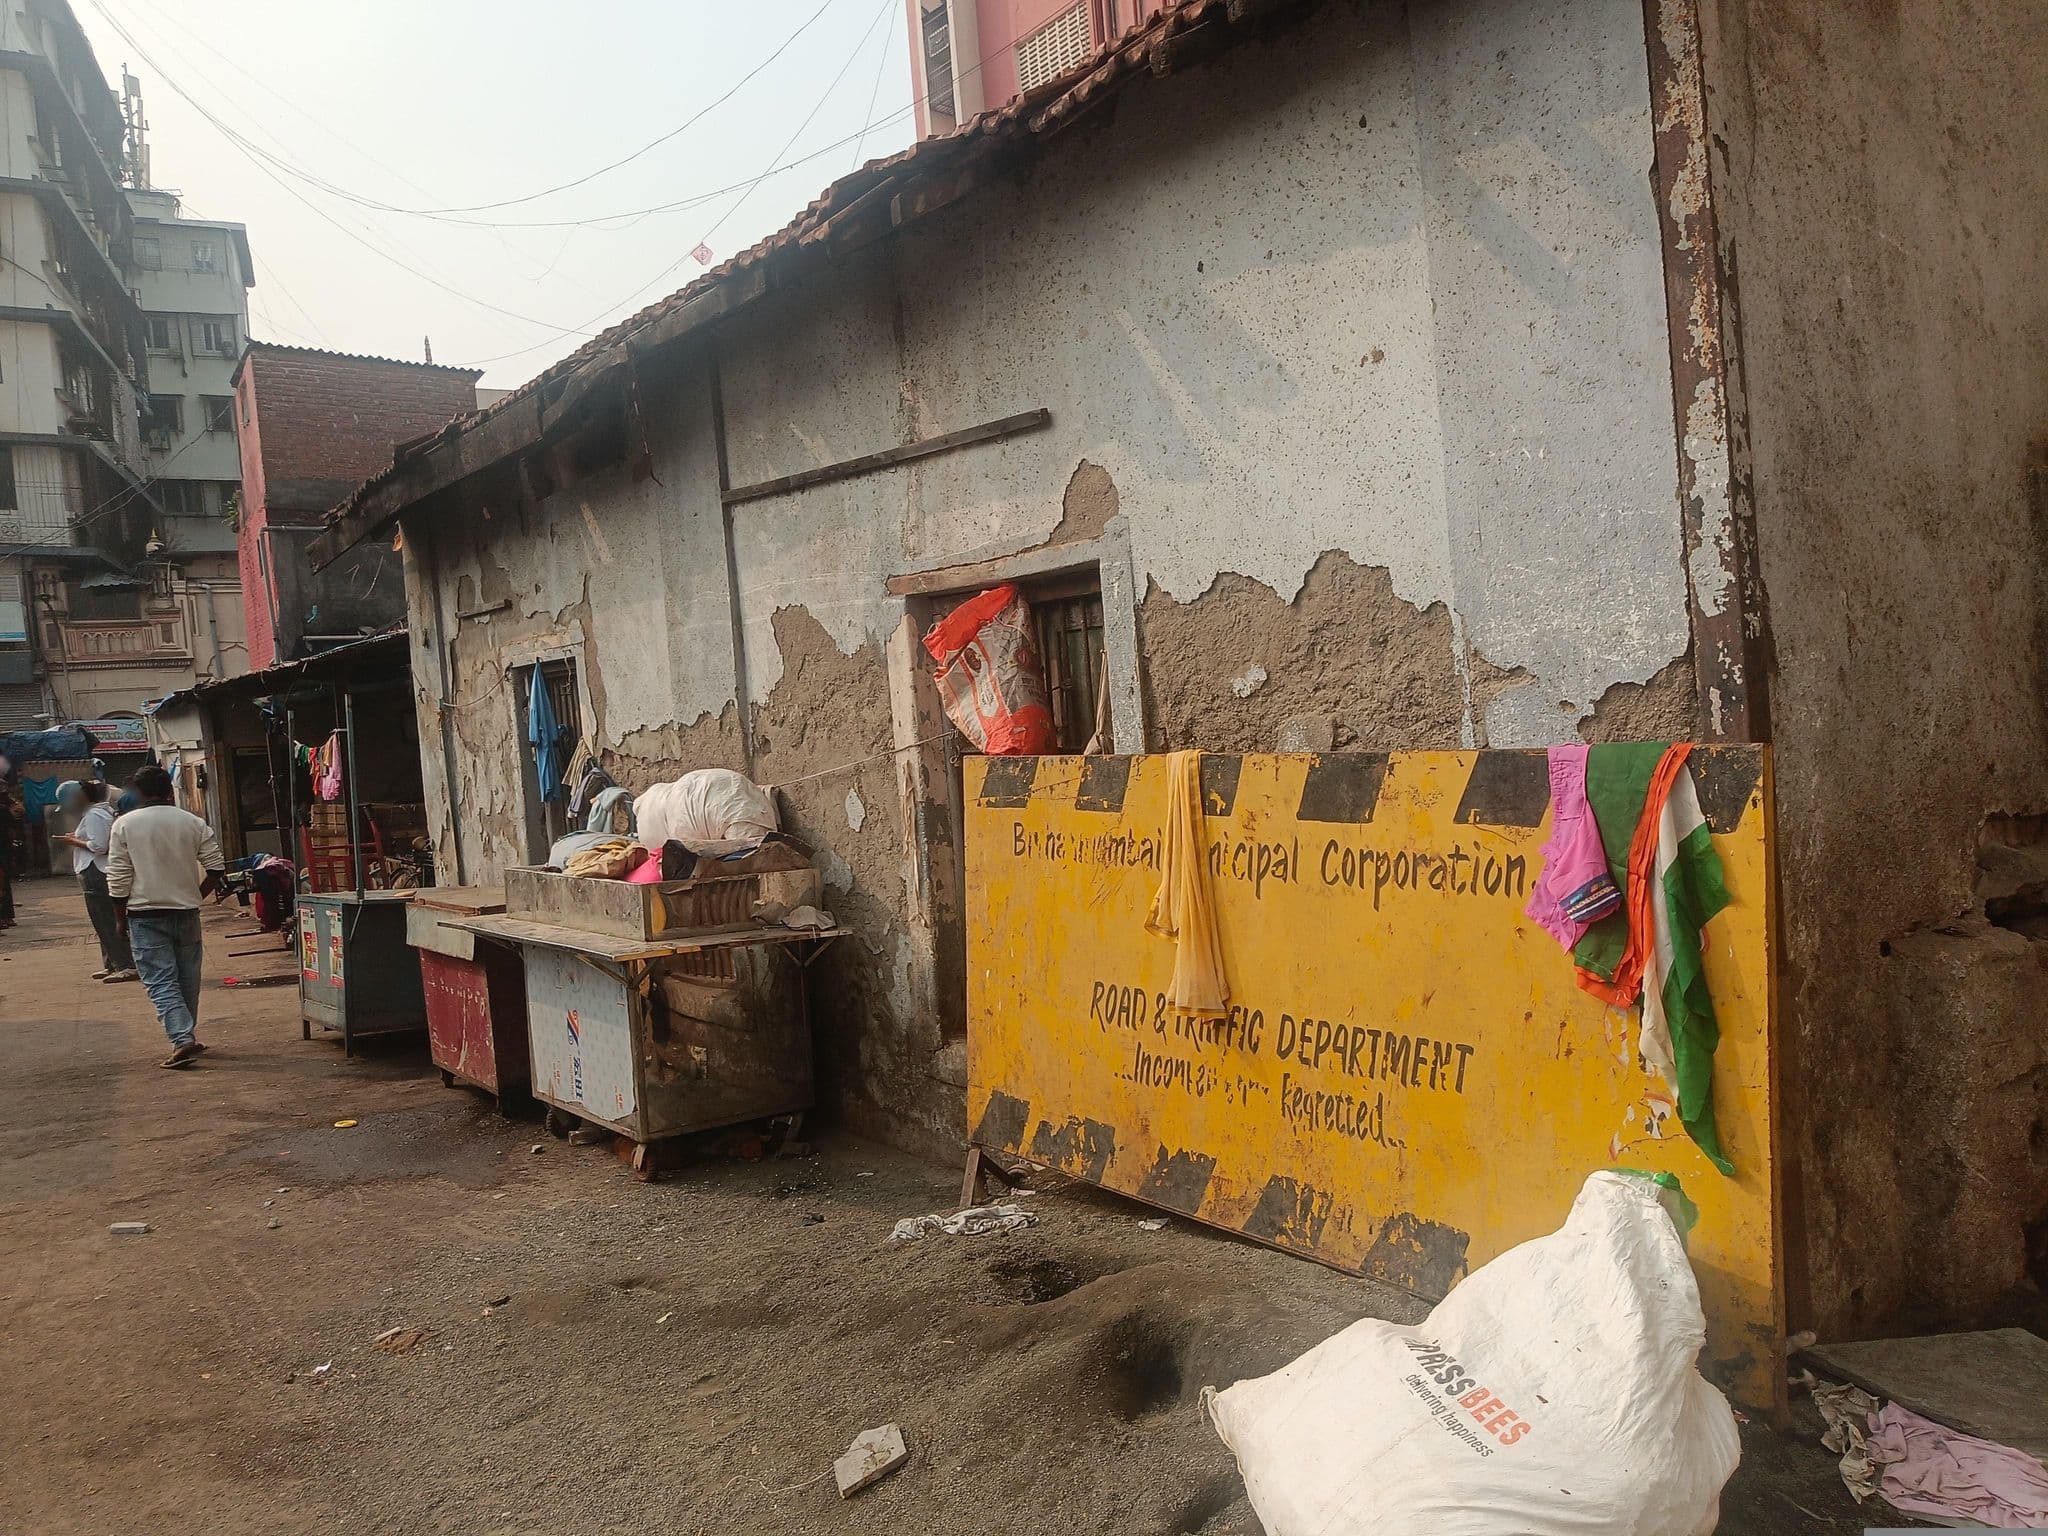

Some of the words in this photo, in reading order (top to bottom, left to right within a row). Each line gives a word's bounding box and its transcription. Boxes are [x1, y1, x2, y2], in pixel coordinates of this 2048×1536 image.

[1208, 831, 1300, 900] nicipal
[1089, 980, 1147, 1034] ROAD
[1153, 991, 1169, 1046] &
[1276, 1013, 1475, 1095] DEPARTMENT
[1405, 1373, 1447, 1416] delivering
[1440, 1411, 1494, 1458] happiness
